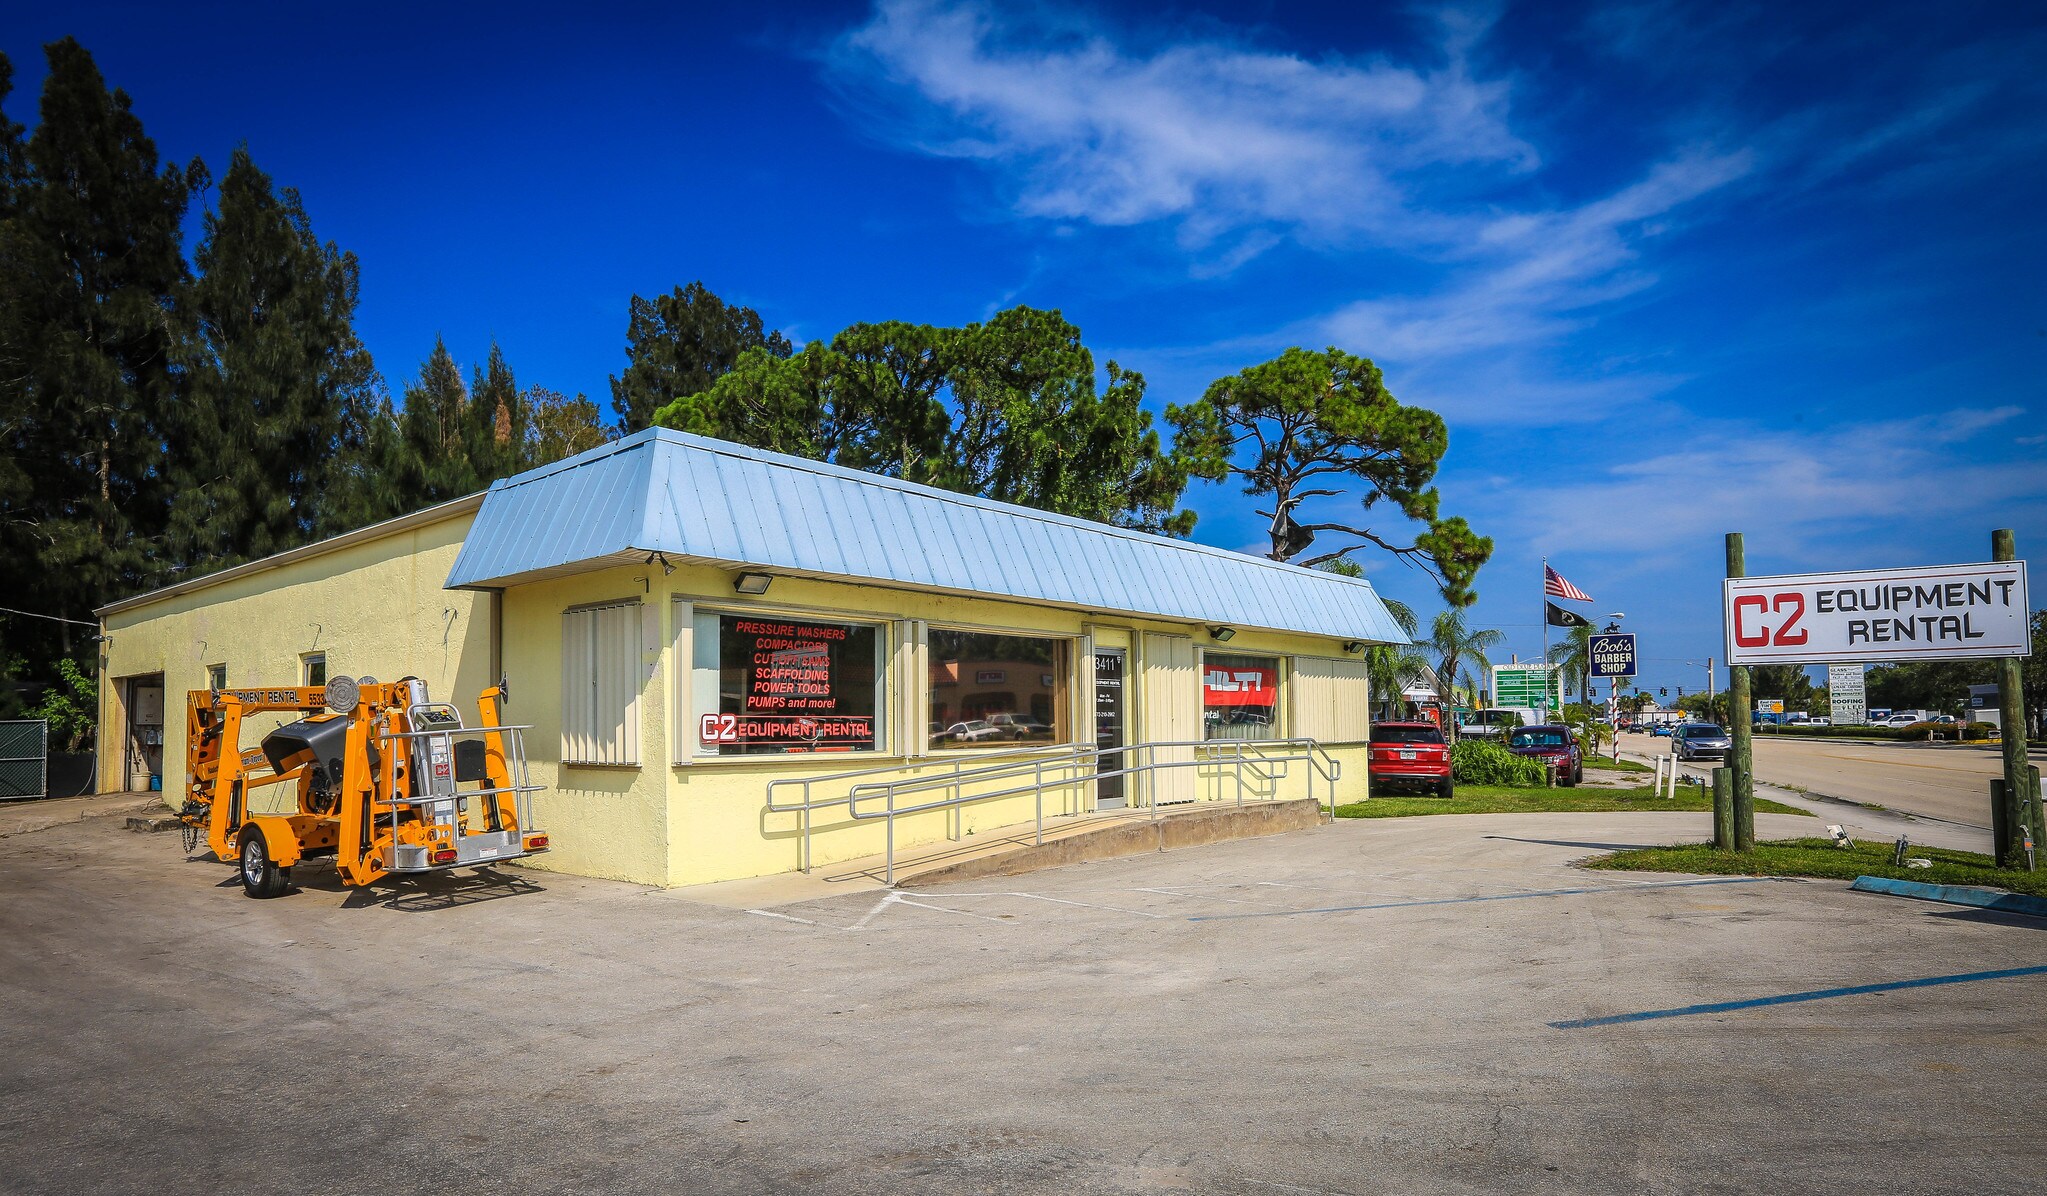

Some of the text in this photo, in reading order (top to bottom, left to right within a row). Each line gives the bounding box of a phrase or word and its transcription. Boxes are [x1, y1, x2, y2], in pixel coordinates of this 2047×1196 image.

[1734, 578, 2017, 648] C2 EQUIPMENT
[736, 621, 846, 640] PRESSURE WASHERS
[1848, 611, 1986, 647] RENTAL
[756, 638, 829, 653] COMPACTORS
[1593, 638, 1632, 653] Bob's
[802, 655, 831, 667] SAWS
[1095, 657, 1115, 671] 3411
[1594, 653, 1632, 664] BARBER
[755, 668, 829, 681] SCAFFOLDING
[1600, 663, 1627, 673] SHOP
[754, 681, 831, 695] POWER TOOLS
[220, 690, 326, 706] PMENT RENTAL 5533
[747, 696, 836, 709] PUMPS and more!
[1204, 710, 1220, 719] ntal
[701, 714, 873, 741] C2 EQUIPMENT RENTAL
